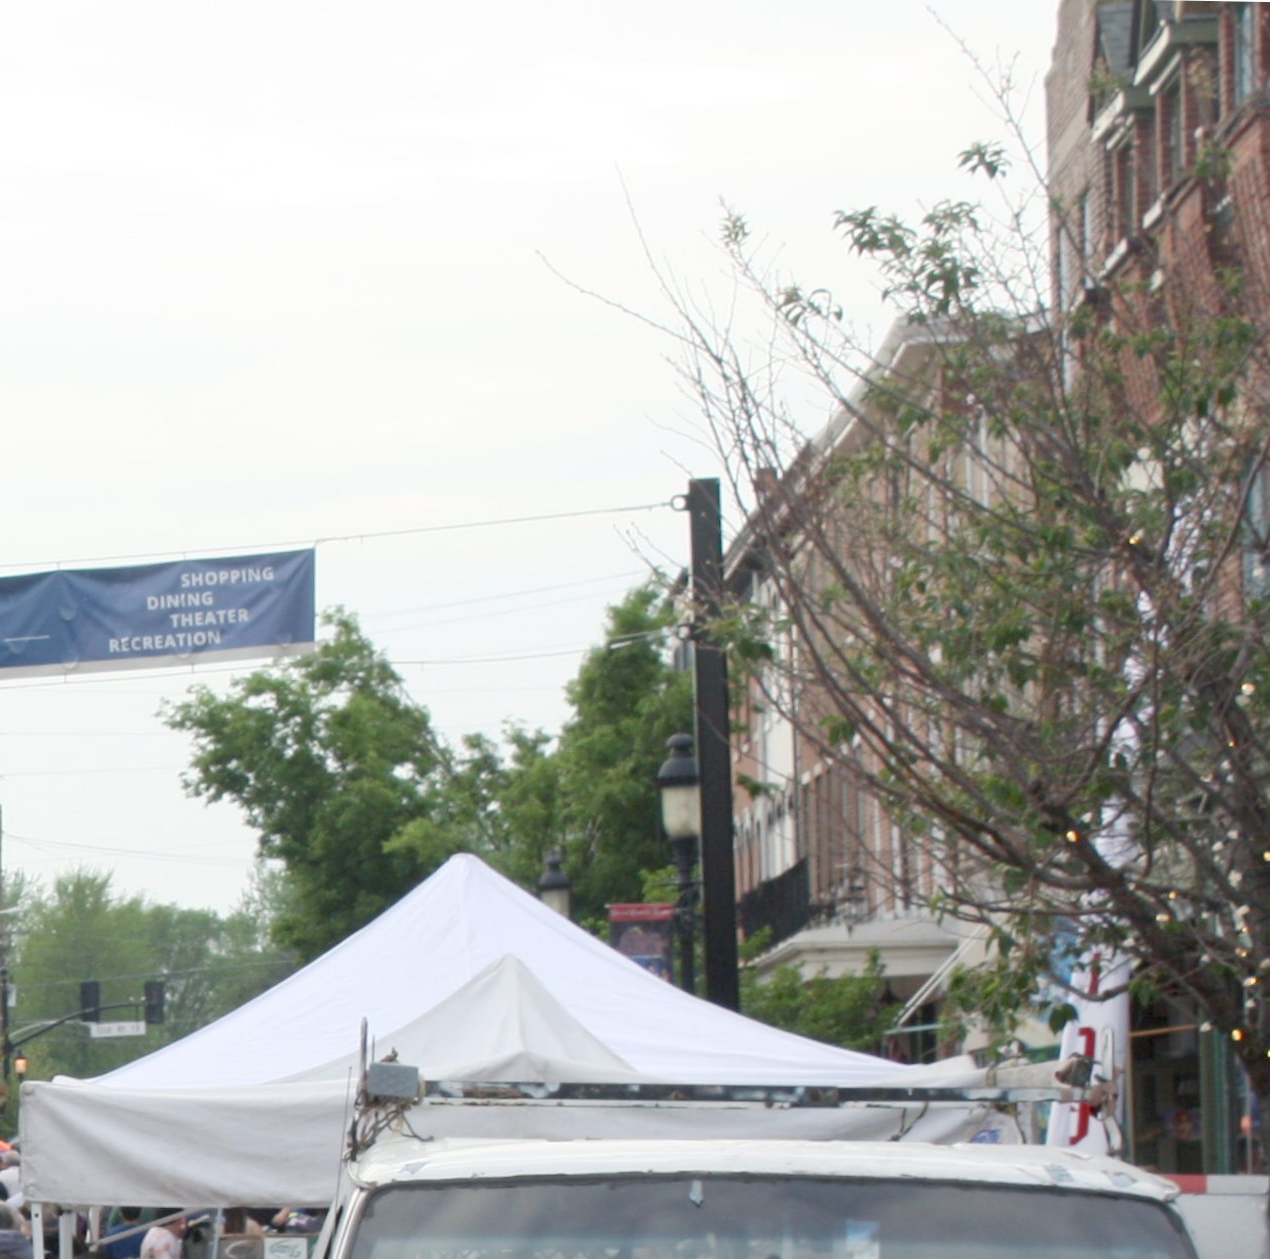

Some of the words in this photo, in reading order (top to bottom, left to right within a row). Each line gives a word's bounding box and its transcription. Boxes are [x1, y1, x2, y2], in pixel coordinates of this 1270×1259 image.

[180, 566, 275, 588] SHOPPING
[147, 592, 214, 610] DINING
[170, 608, 250, 628] THEATER
[109, 631, 222, 653] RECREATION
